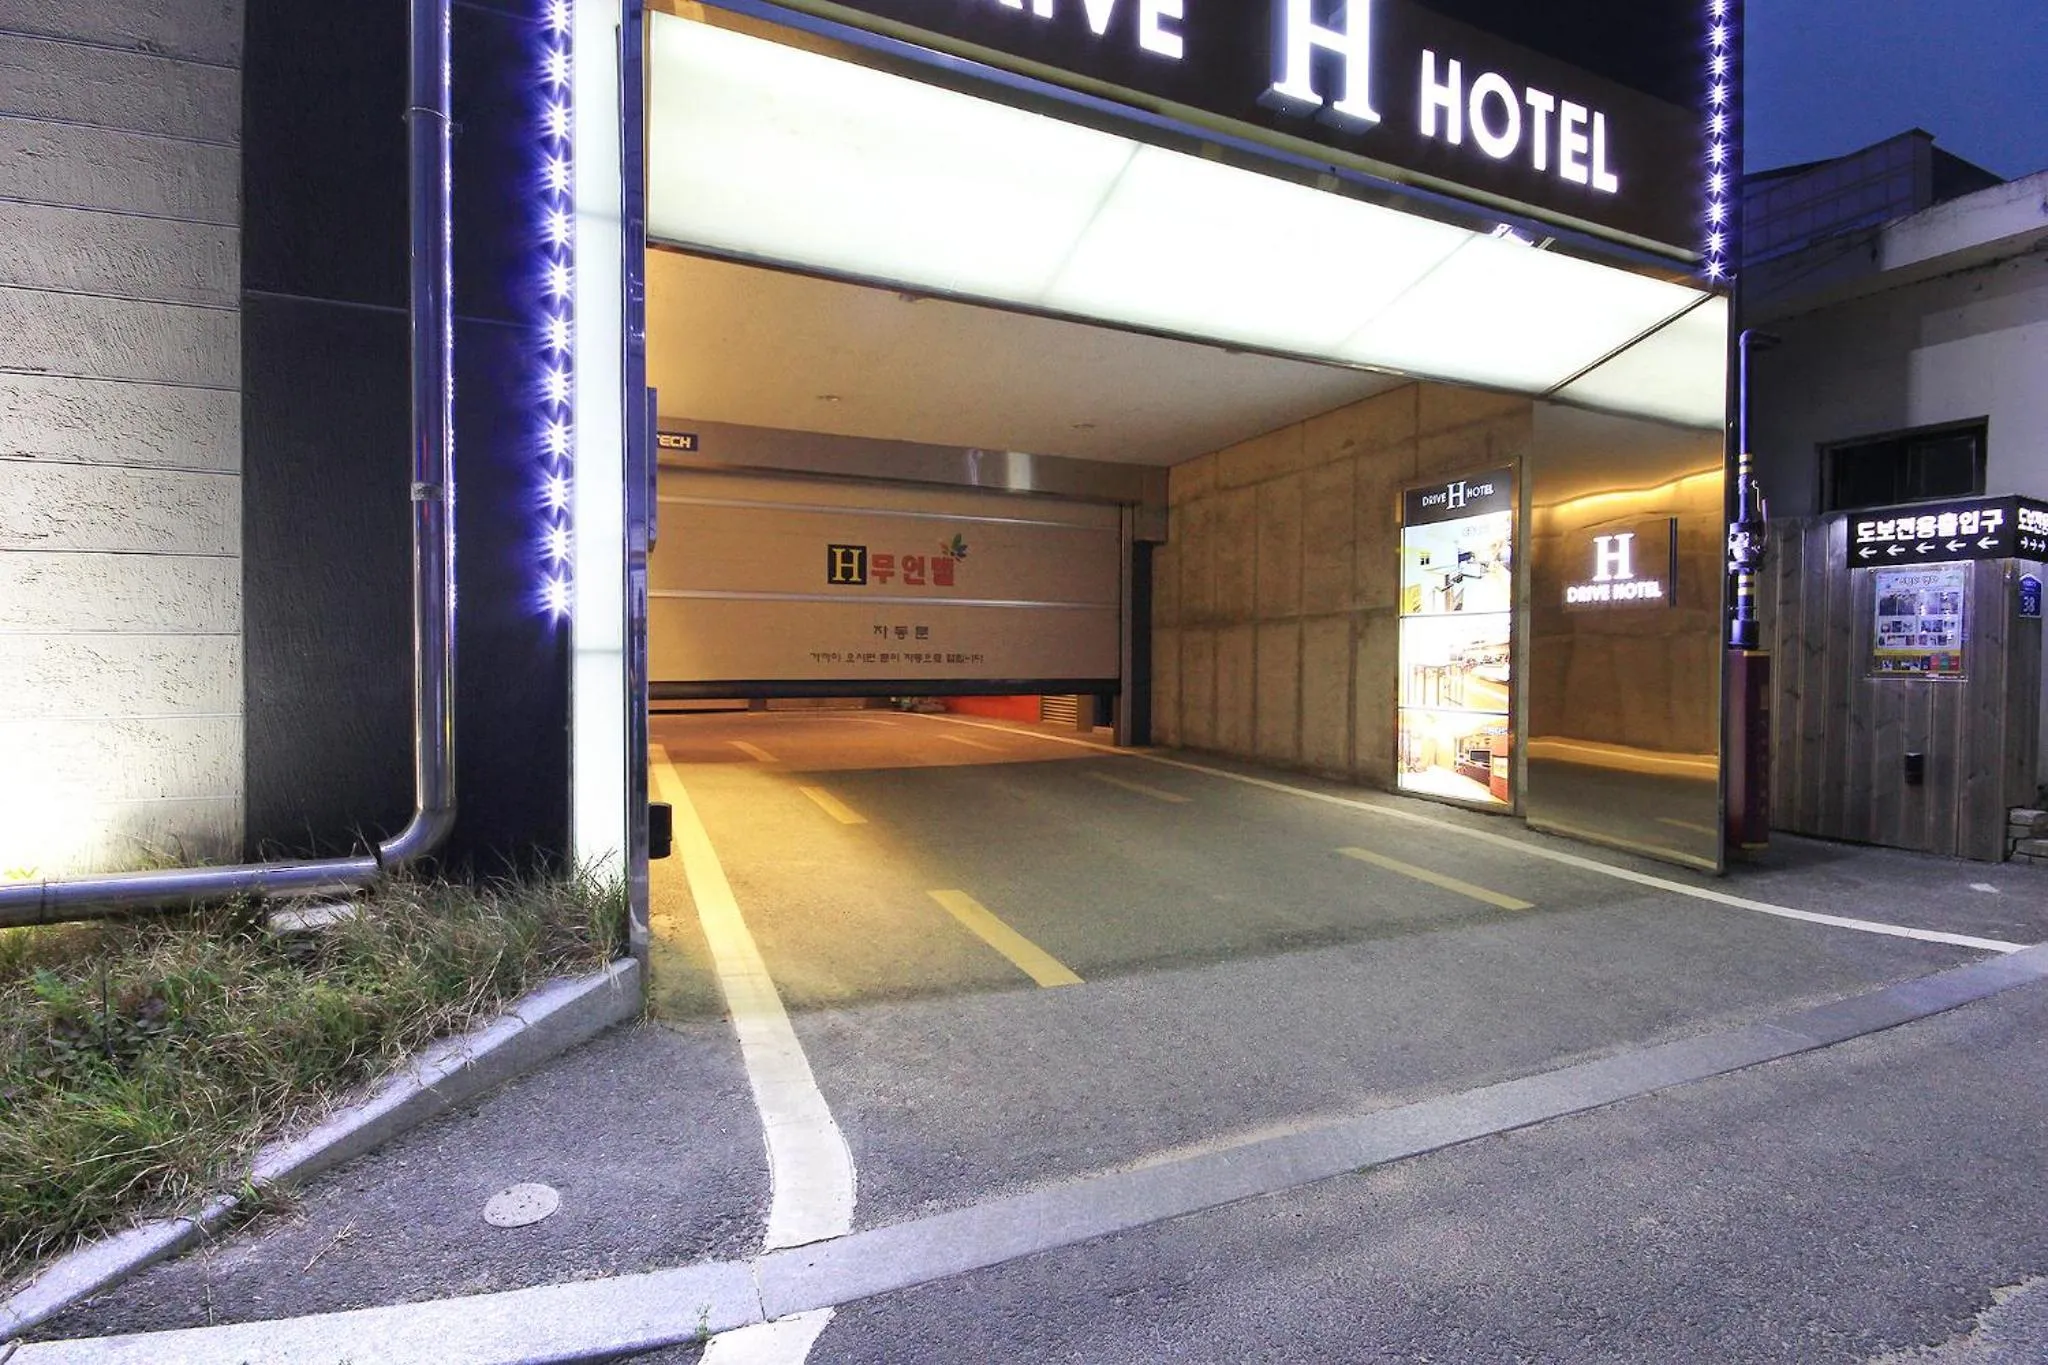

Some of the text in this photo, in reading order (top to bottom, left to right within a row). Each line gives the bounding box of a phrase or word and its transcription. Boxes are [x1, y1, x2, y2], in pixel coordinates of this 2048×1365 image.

[1272, 0, 1381, 123] H
[1420, 49, 1618, 193] HOTEL
[656, 434, 691, 449] ECH
[1422, 481, 1495, 510] DRIVE H HOTEL
[1856, 508, 2004, 543] 도보전용출입구
[831, 547, 863, 582] H
[1592, 533, 1635, 582] H
[1566, 581, 1663, 603] DRIVE HOTEL
[873, 625, 929, 640] 자동문
